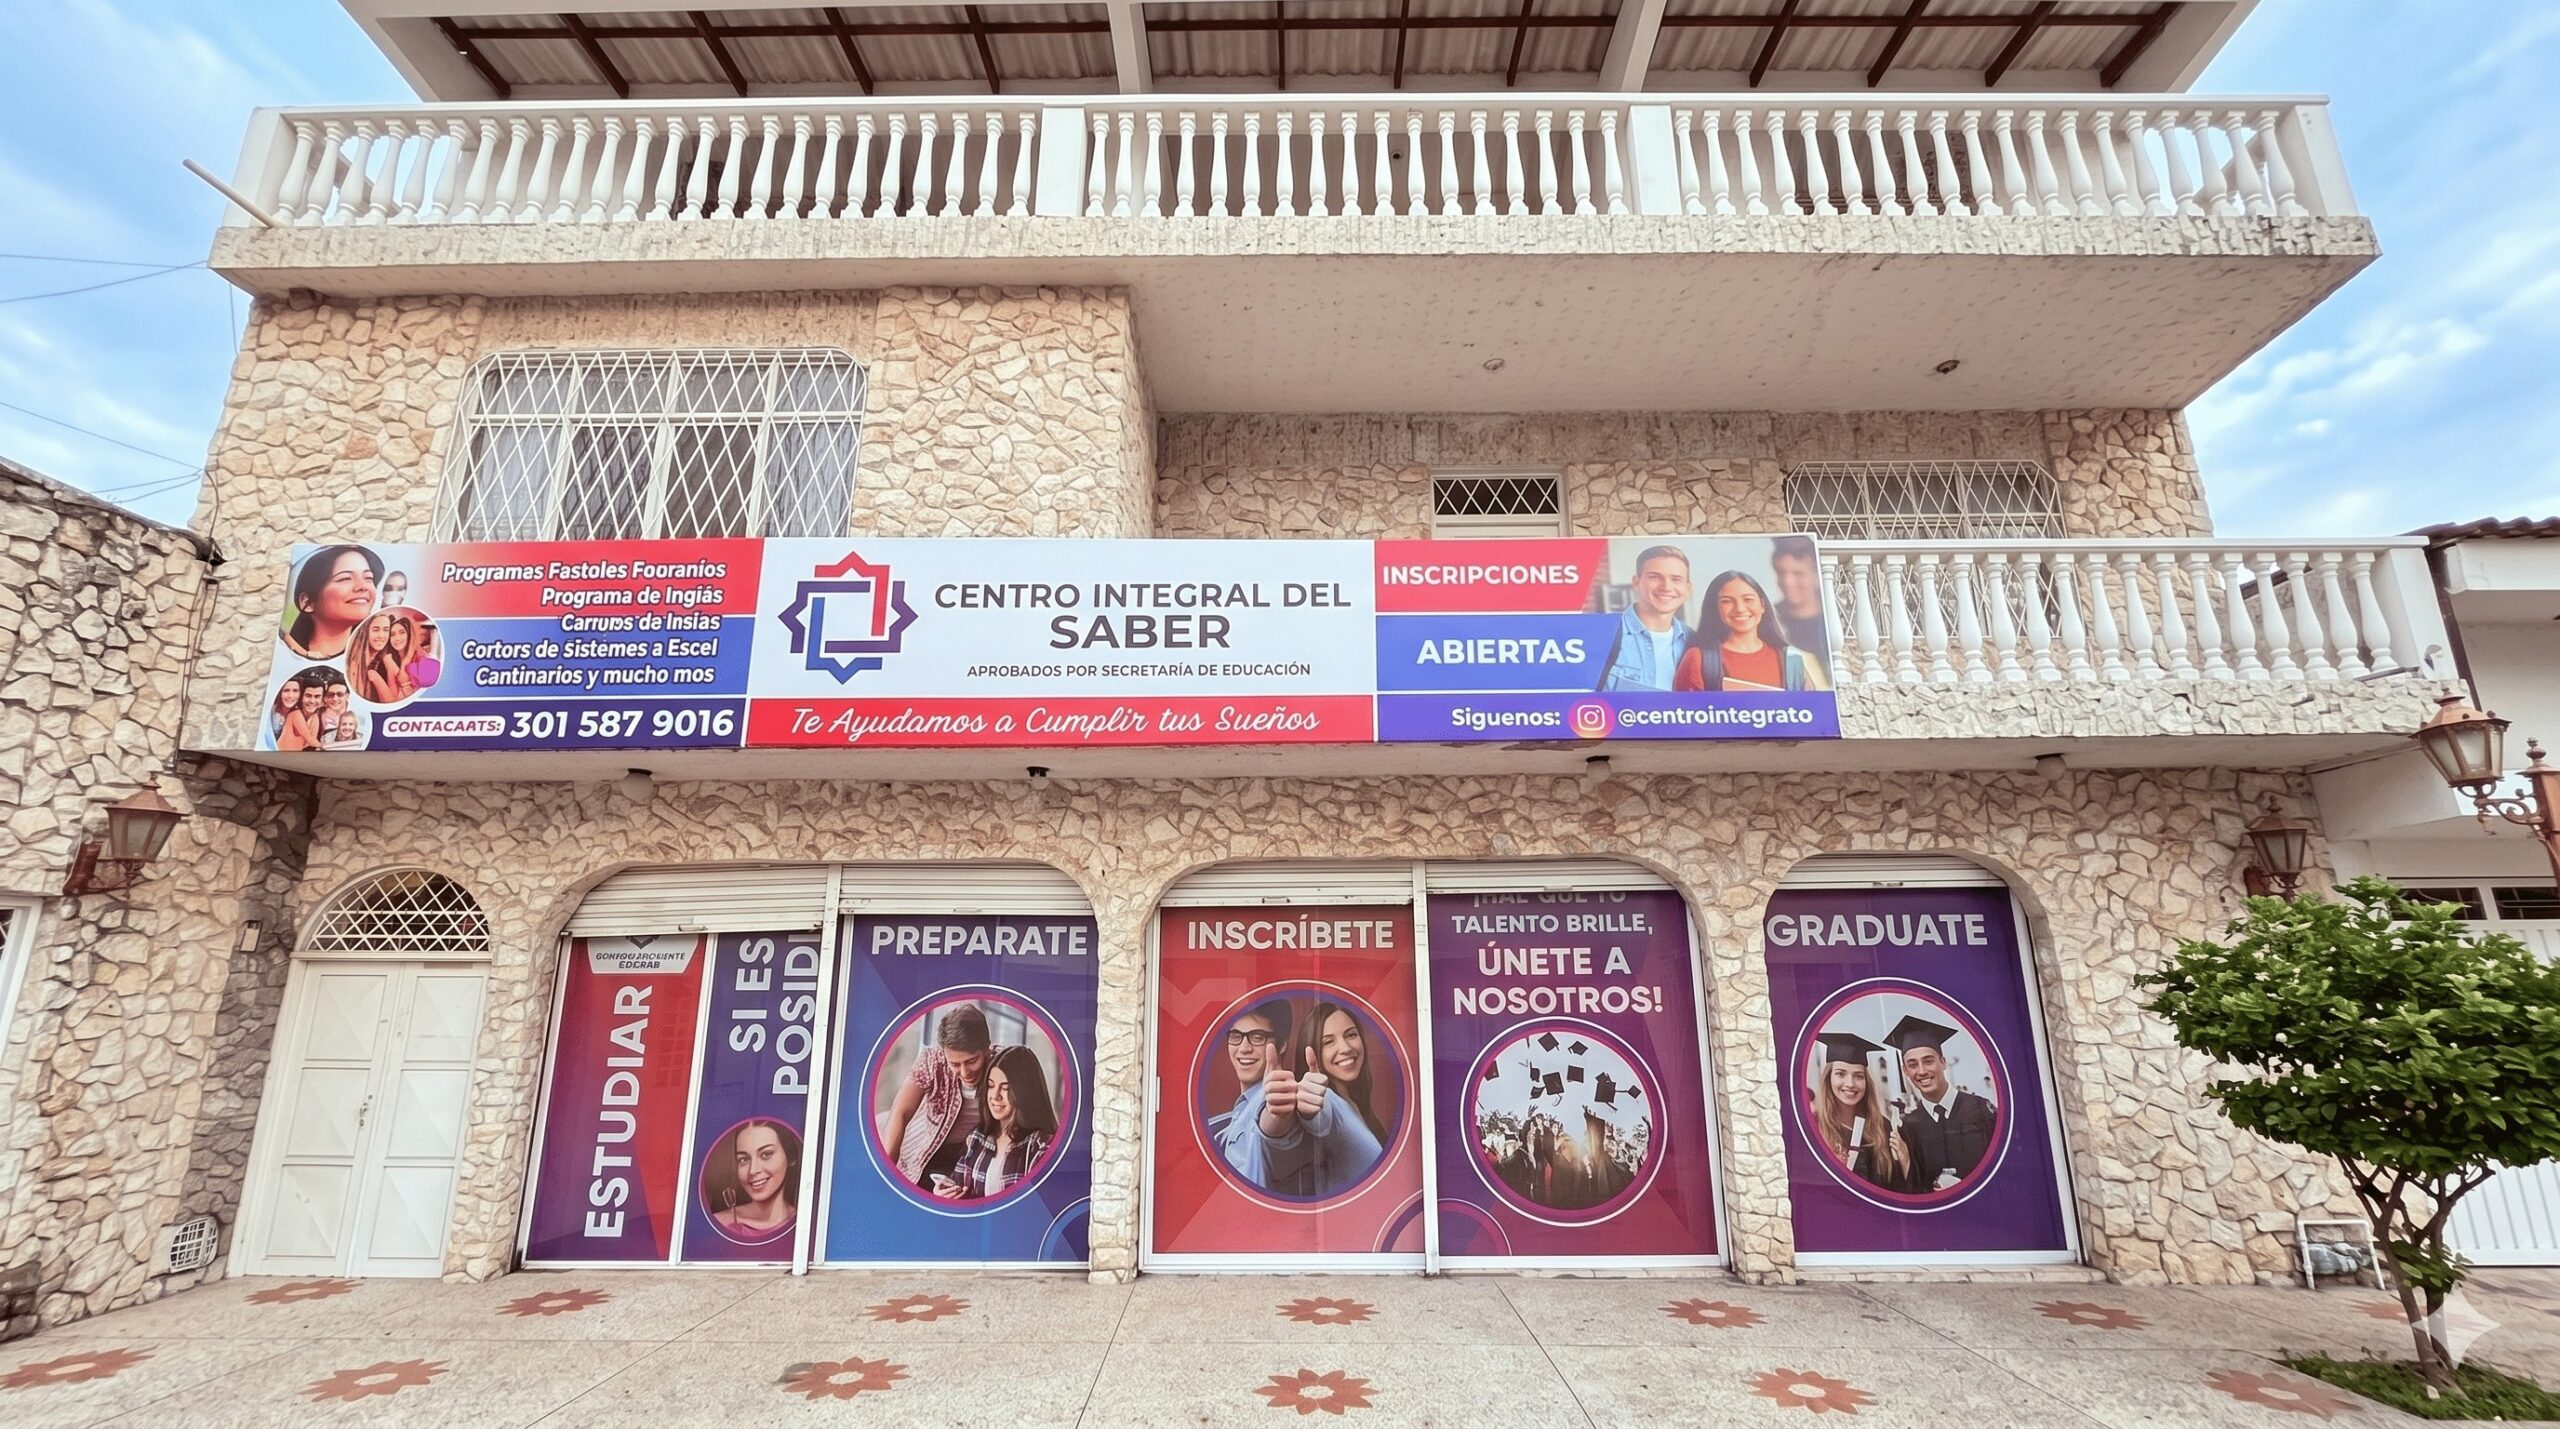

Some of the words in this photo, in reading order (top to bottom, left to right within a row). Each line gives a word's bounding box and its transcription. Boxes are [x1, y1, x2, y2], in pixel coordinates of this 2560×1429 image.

[548, 560, 627, 579] Fastoles
[1382, 565, 1579, 585] INSCRIPCIONES
[541, 587, 632, 608] Programa
[637, 586, 661, 604] de
[935, 583, 1080, 609] CENTRO
[1093, 583, 1271, 608] INTEGRAL
[1284, 582, 1351, 607] DEL
[1049, 615, 1231, 649] SABER
[462, 640, 530, 659] Cortors
[535, 639, 558, 658] de
[652, 642, 662, 657] a
[667, 638, 718, 656] Escel
[1417, 639, 1586, 665] ABIERTAS
[475, 666, 583, 686] Cantinarios
[585, 669, 599, 689] y
[603, 665, 669, 684] mucho
[673, 667, 714, 683] mos
[967, 664, 1062, 677] APROBADOS
[1066, 664, 1098, 677] POR
[1101, 661, 1194, 677] SECRETARÍA
[1198, 664, 1219, 676] DE
[1222, 661, 1311, 676] EDUCACIÓN
[509, 711, 568, 739] 301
[577, 710, 643, 737] 587
[652, 709, 735, 737] 9016
[791, 707, 822, 734] Te
[828, 708, 988, 742] Ayudamos
[995, 717, 1016, 733] a
[1025, 706, 1149, 740] Cumplir
[1159, 709, 1203, 731] tus
[1214, 705, 1320, 731] Sueños
[1451, 706, 1561, 731] Siguenos:
[1618, 705, 1813, 728] @centrointegrato
[1187, 914, 1394, 950] INSCRÍBETE
[1451, 915, 1559, 933] TALENTO
[1567, 913, 1653, 935] BRILLE,
[1766, 913, 1988, 947] GRADUATE
[871, 926, 1088, 956] PREPARATE
[735, 936, 775, 991] ES
[1478, 940, 1593, 976] ÚNETE
[1603, 947, 1632, 974] A
[1453, 986, 1663, 1015] NOSOTROS!
[729, 1008, 767, 1053] SI
[583, 985, 653, 1238] ESTUDIAR
